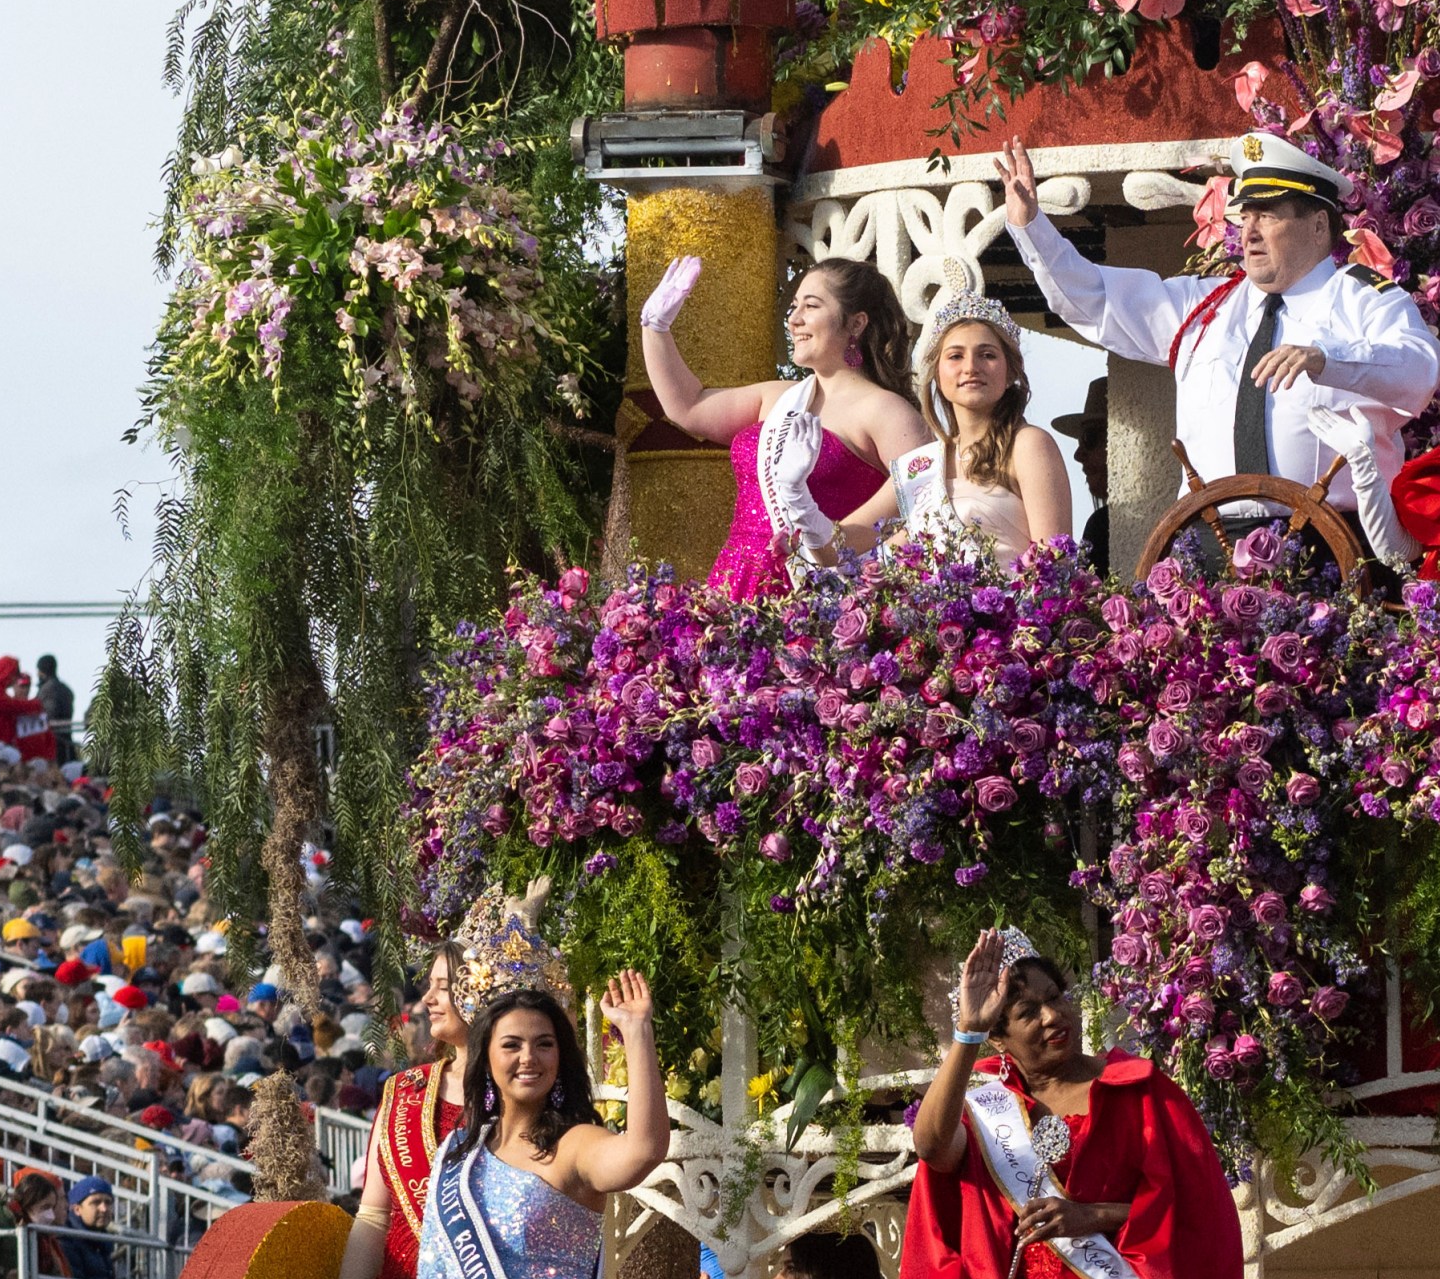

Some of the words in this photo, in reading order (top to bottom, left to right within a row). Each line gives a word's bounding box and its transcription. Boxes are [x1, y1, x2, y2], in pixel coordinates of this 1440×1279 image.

[395, 1093, 421, 1167] Louisiana
[995, 1124, 1020, 1168] Queen
[441, 1175, 466, 1226] SCOTT
[1071, 1238, 1119, 1278] Krewe
